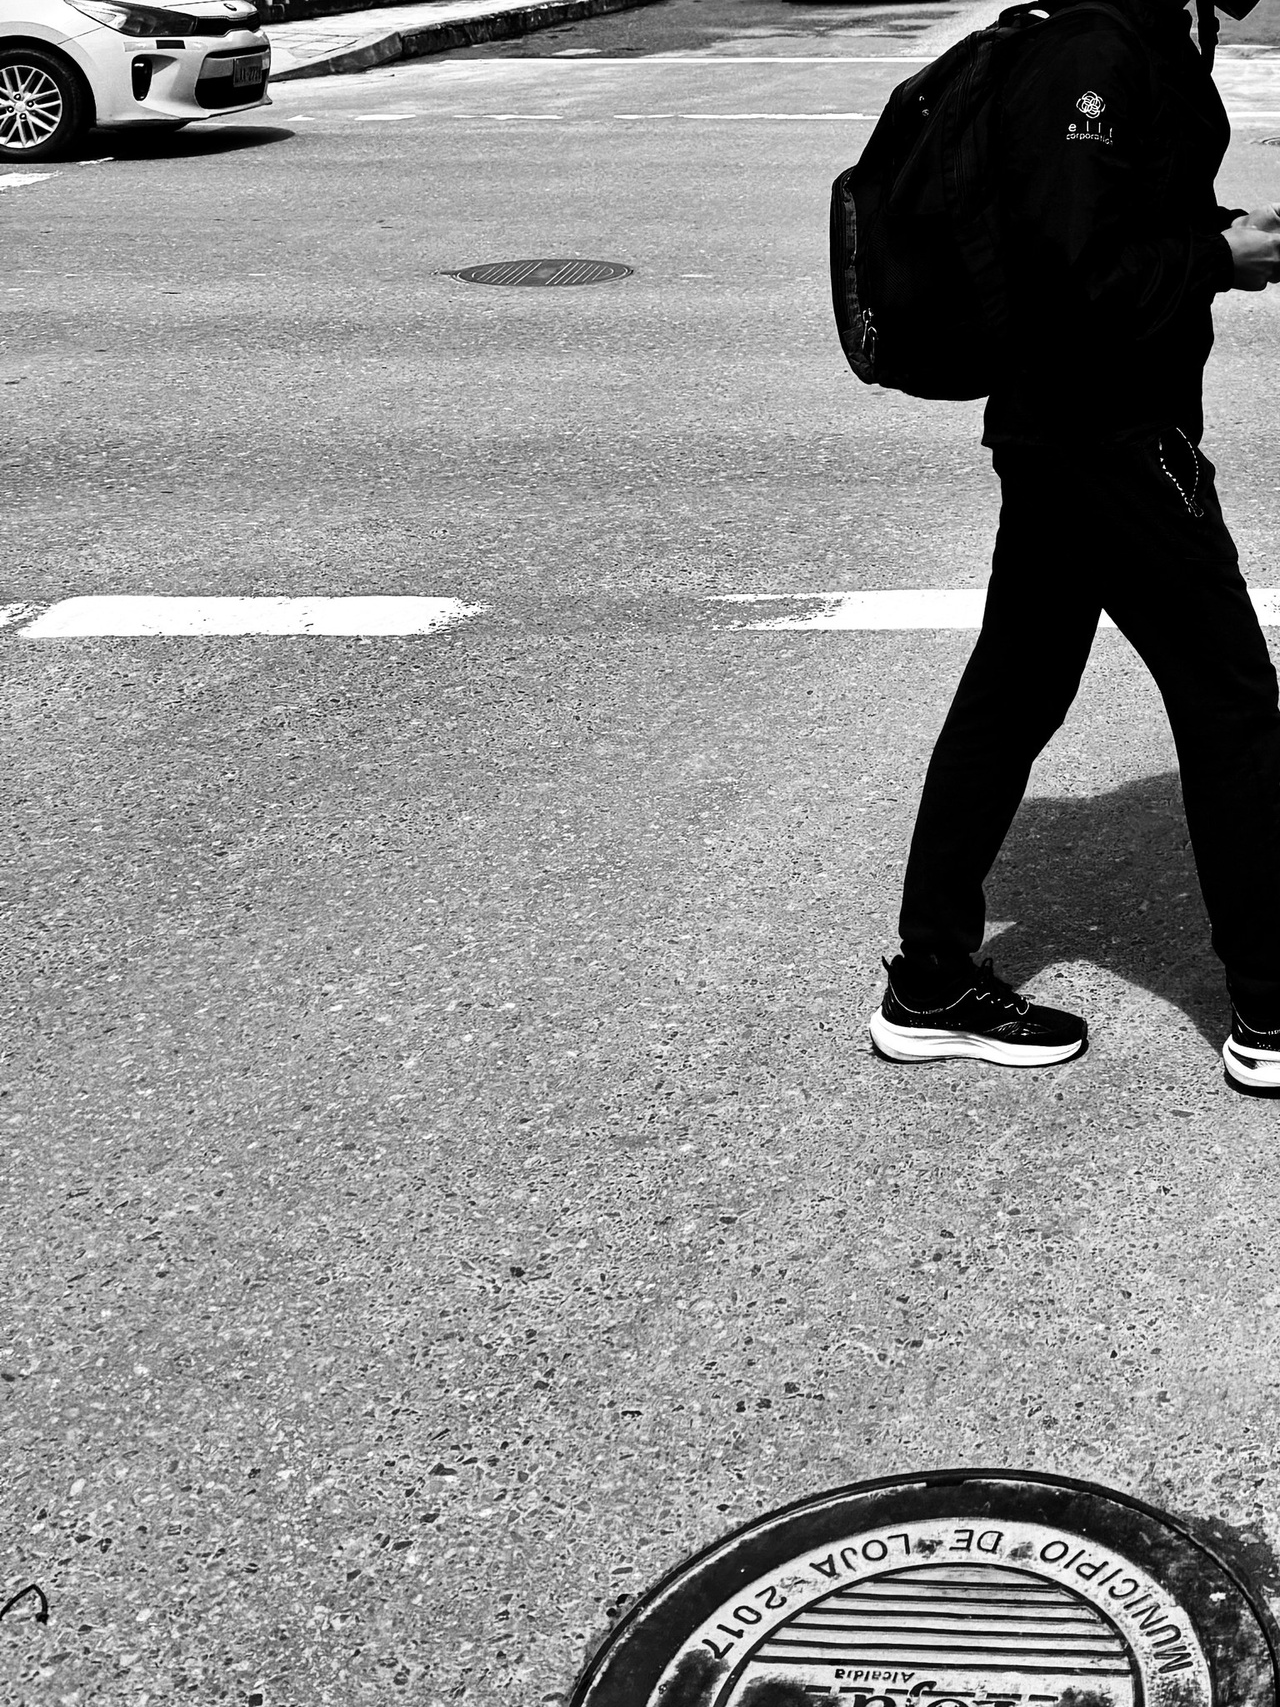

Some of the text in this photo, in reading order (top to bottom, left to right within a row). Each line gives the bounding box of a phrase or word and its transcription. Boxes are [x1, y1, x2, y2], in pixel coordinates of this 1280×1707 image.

[702, 1527, 1195, 1674] MUNICIPIO DE LOJA 2017
